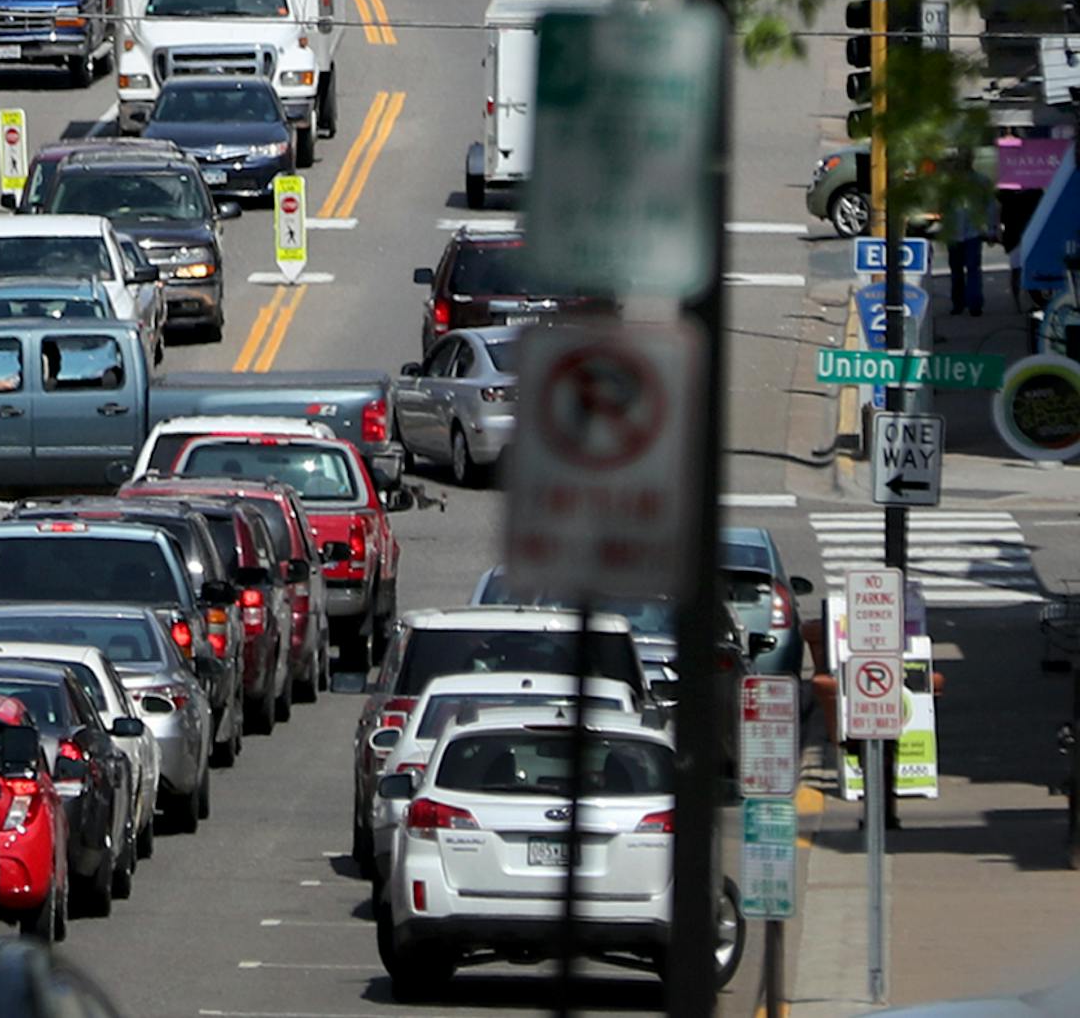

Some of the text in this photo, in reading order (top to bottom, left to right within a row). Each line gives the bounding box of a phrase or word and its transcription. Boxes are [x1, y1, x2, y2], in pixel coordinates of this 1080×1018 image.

[866, 244, 914, 268] ED
[818, 352, 985, 386] Union Alley
[885, 423, 934, 445] ONE
[883, 448, 935, 470] WAY
[866, 575, 883, 589] NO
[856, 592, 896, 605] PARKING
